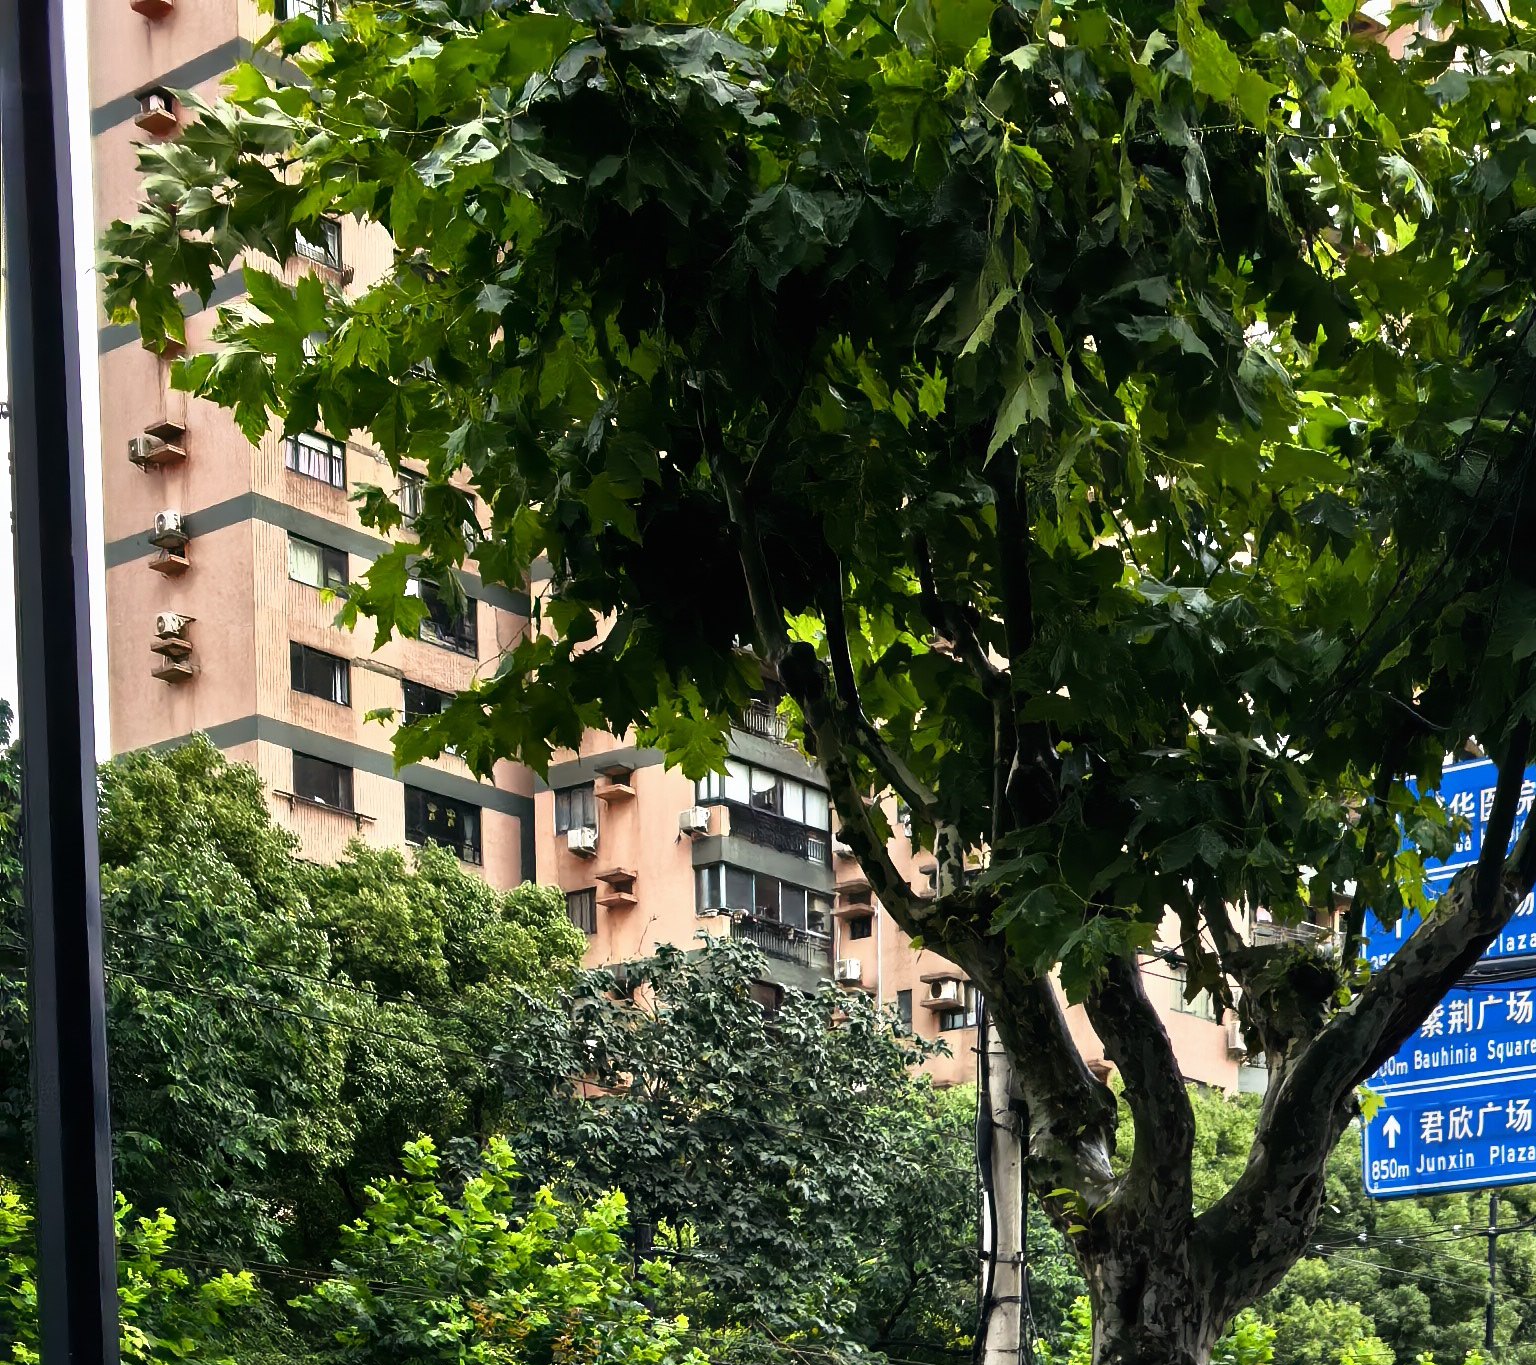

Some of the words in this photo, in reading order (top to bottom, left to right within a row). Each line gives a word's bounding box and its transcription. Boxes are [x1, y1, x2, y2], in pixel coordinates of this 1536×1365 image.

[1420, 990, 1533, 1039] 紫荆广场
[1372, 1055, 1409, 1079] 00m
[1414, 1042, 1477, 1070] Bauhinia
[1420, 1099, 1533, 1144] 君欣广场
[1371, 1158, 1410, 1181] 850m
[1416, 1149, 1475, 1174] Junxin
[1490, 1145, 1536, 1165] Plaza
